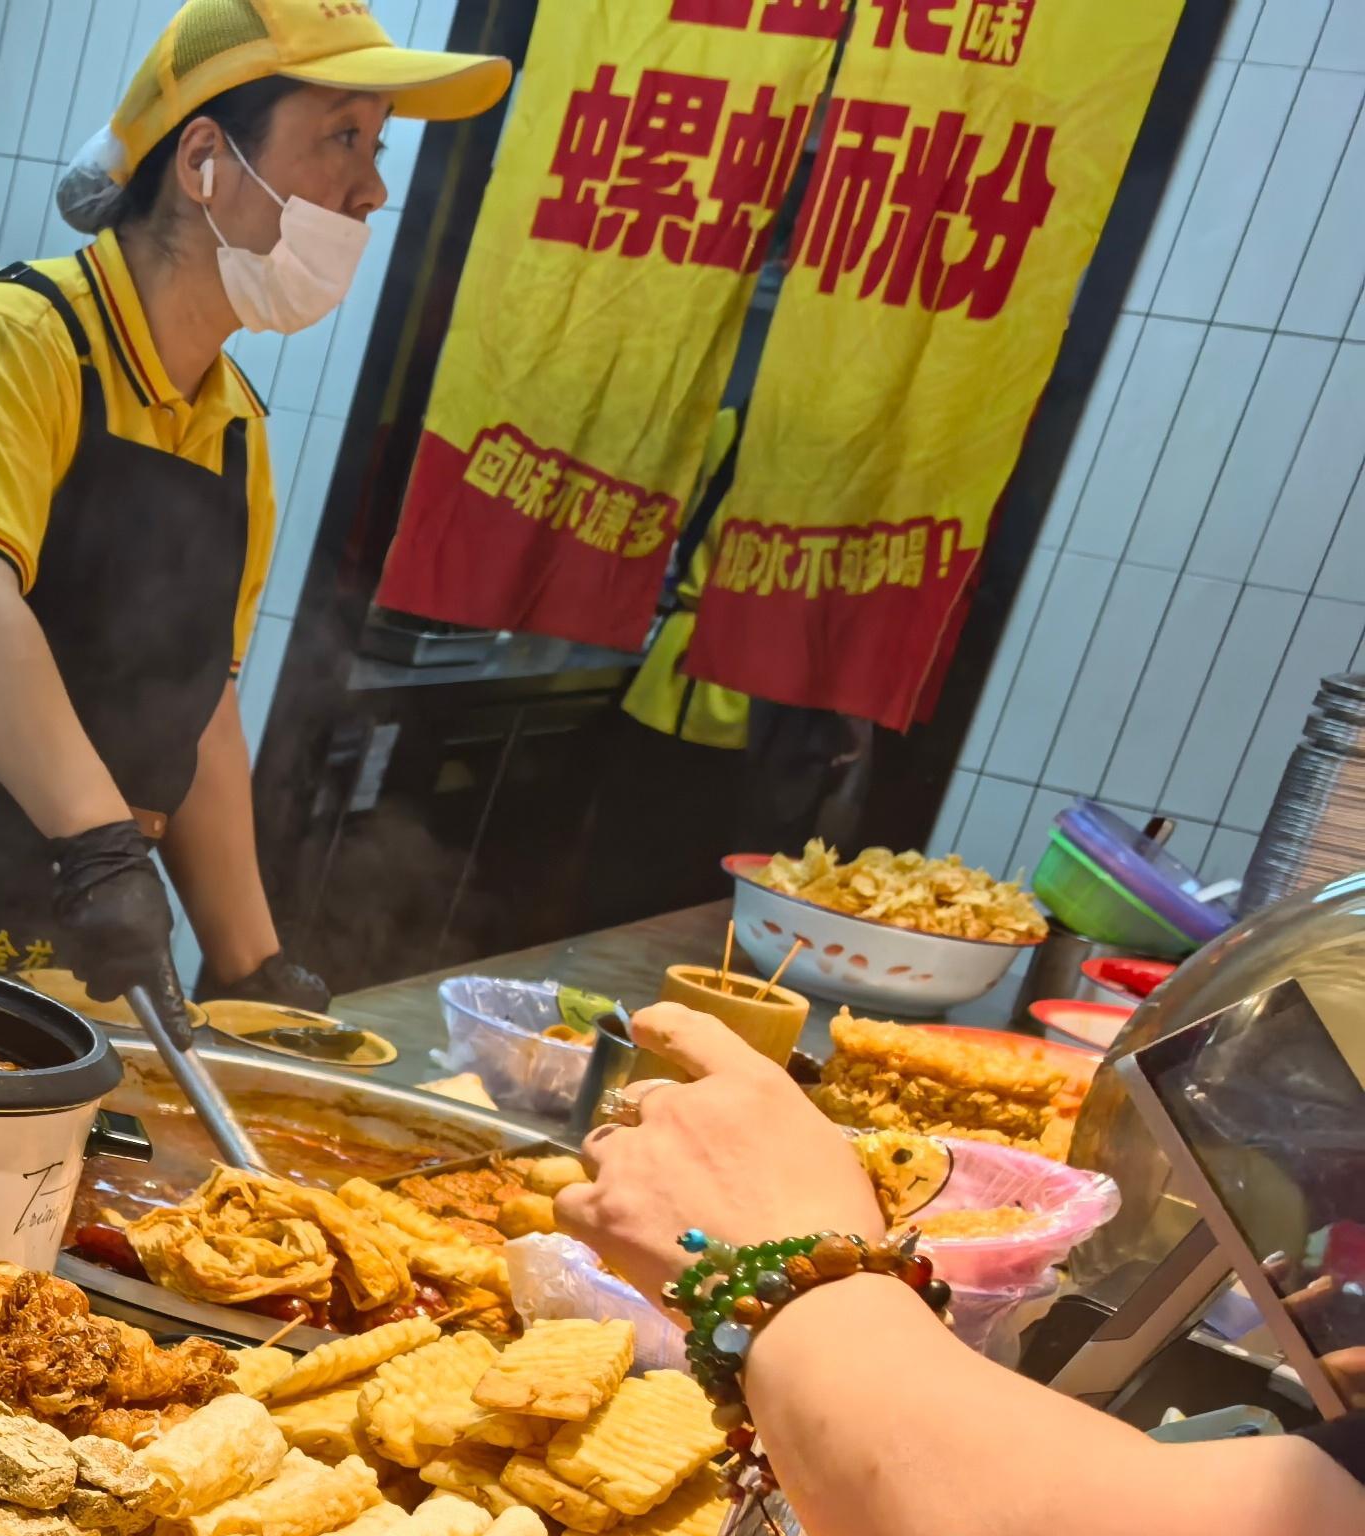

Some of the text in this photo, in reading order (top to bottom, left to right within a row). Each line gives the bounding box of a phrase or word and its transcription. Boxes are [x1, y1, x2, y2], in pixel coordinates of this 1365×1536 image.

[530, 64, 1056, 321] 螺蛳粉
[463, 433, 668, 559] 卤味不嫌多
